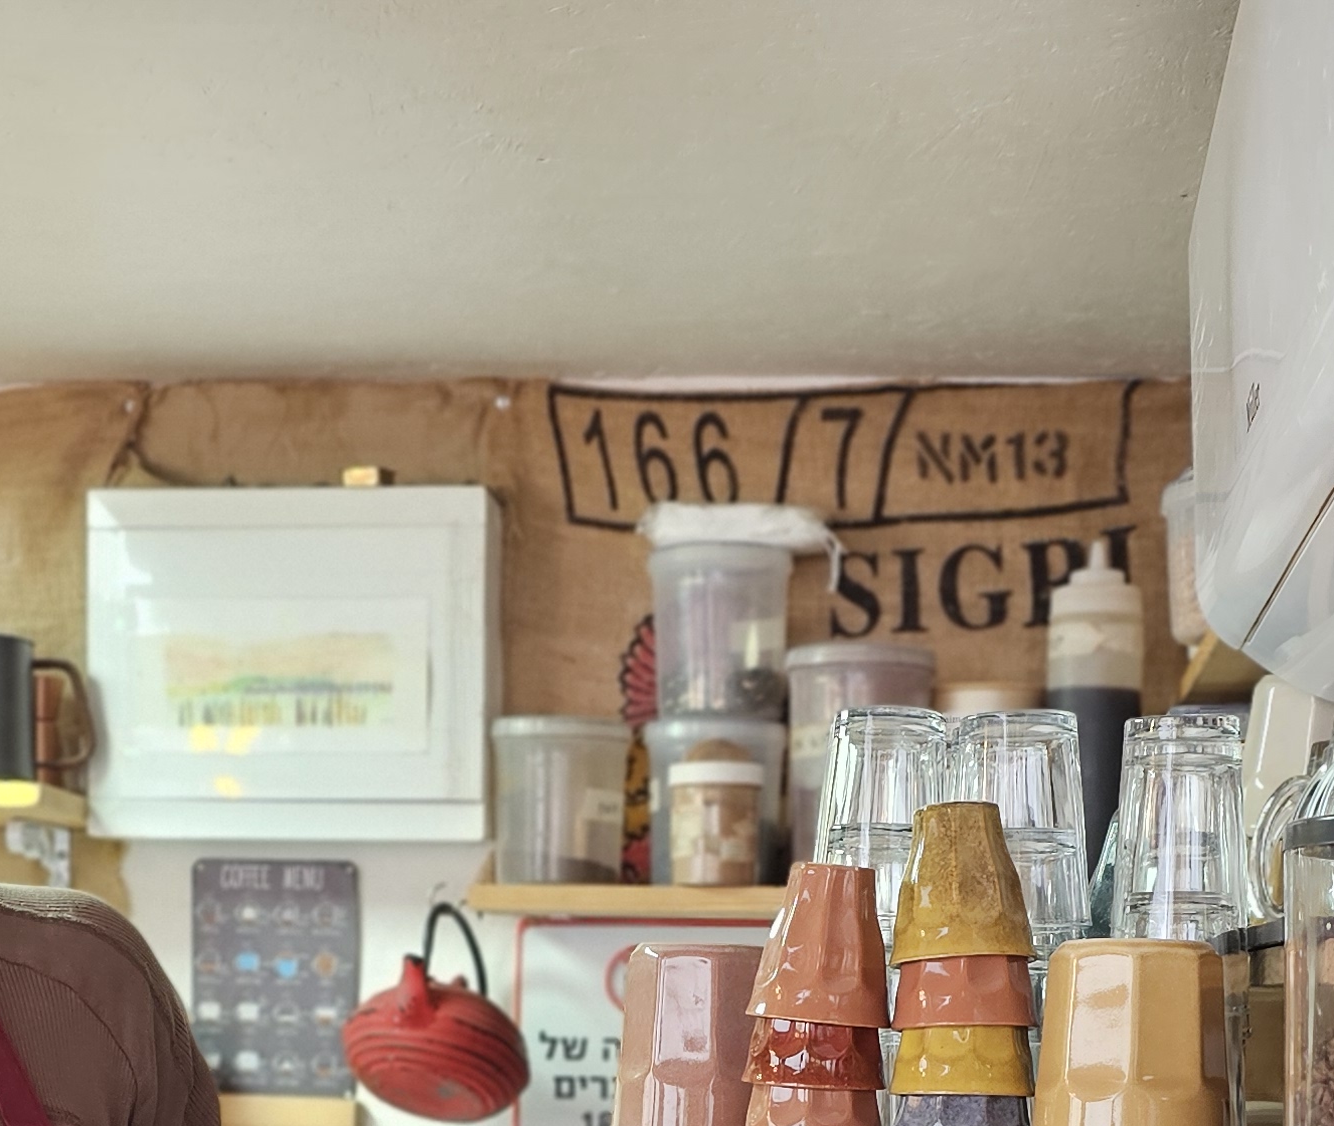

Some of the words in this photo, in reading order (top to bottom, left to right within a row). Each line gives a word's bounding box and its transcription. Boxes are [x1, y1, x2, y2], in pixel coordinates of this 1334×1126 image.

[584, 409, 739, 510] 166
[821, 407, 862, 510] 7
[917, 430, 1069, 485] NM13
[219, 865, 271, 890] COFFEE
[538, 1029, 588, 1061] של
[553, 1075, 617, 1100] רים
